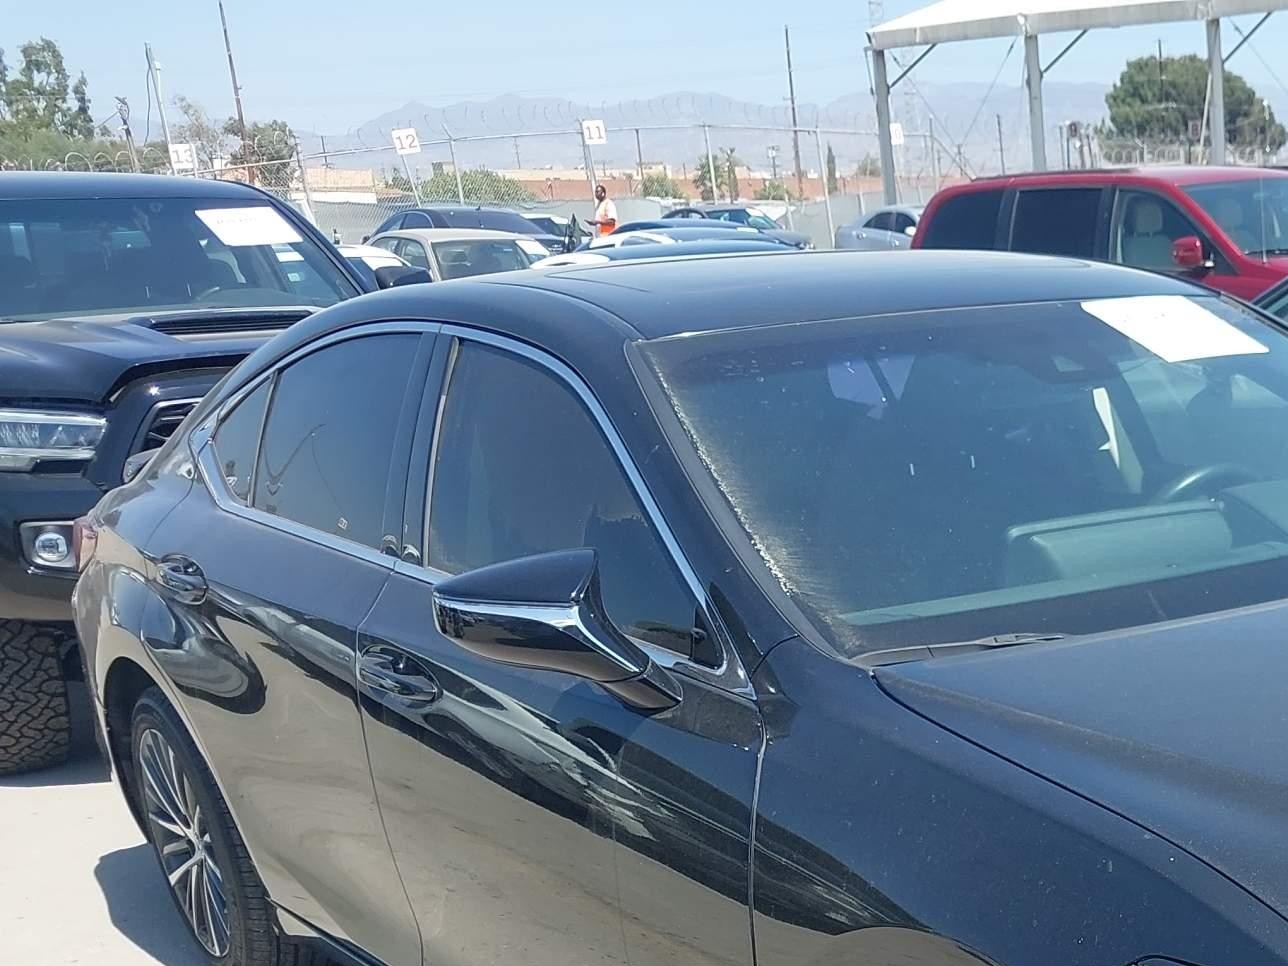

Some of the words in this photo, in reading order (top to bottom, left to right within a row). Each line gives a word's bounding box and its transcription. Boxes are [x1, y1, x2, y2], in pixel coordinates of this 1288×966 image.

[586, 126, 604, 140] 11
[395, 134, 418, 149] 12
[172, 150, 193, 163] 13
